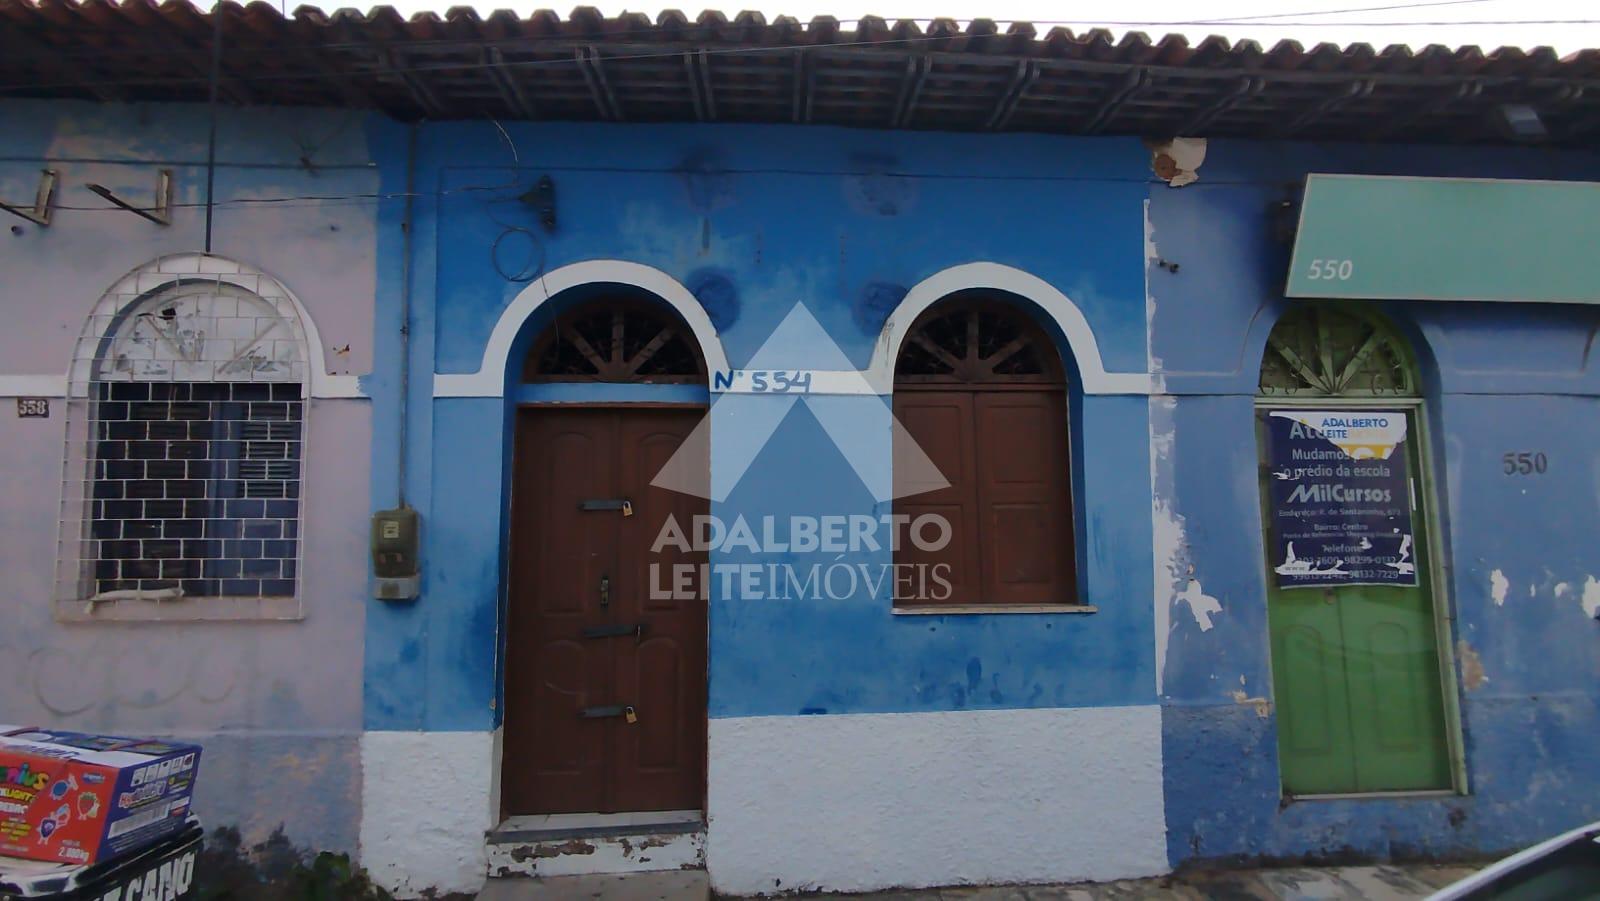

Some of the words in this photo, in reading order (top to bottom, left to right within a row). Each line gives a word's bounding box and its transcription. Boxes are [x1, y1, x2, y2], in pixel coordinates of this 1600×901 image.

[1307, 258, 1354, 281] 550
[751, 371, 812, 393] 554
[19, 400, 47, 415] 558
[1321, 418, 1389, 428] ADALBERTO
[1324, 429, 1348, 439] LEITE
[1294, 463, 1333, 480] prédio
[1336, 463, 1351, 477] da
[1354, 464, 1391, 477] escola
[1503, 452, 1548, 476] 550
[1286, 483, 1392, 503] MilCursos
